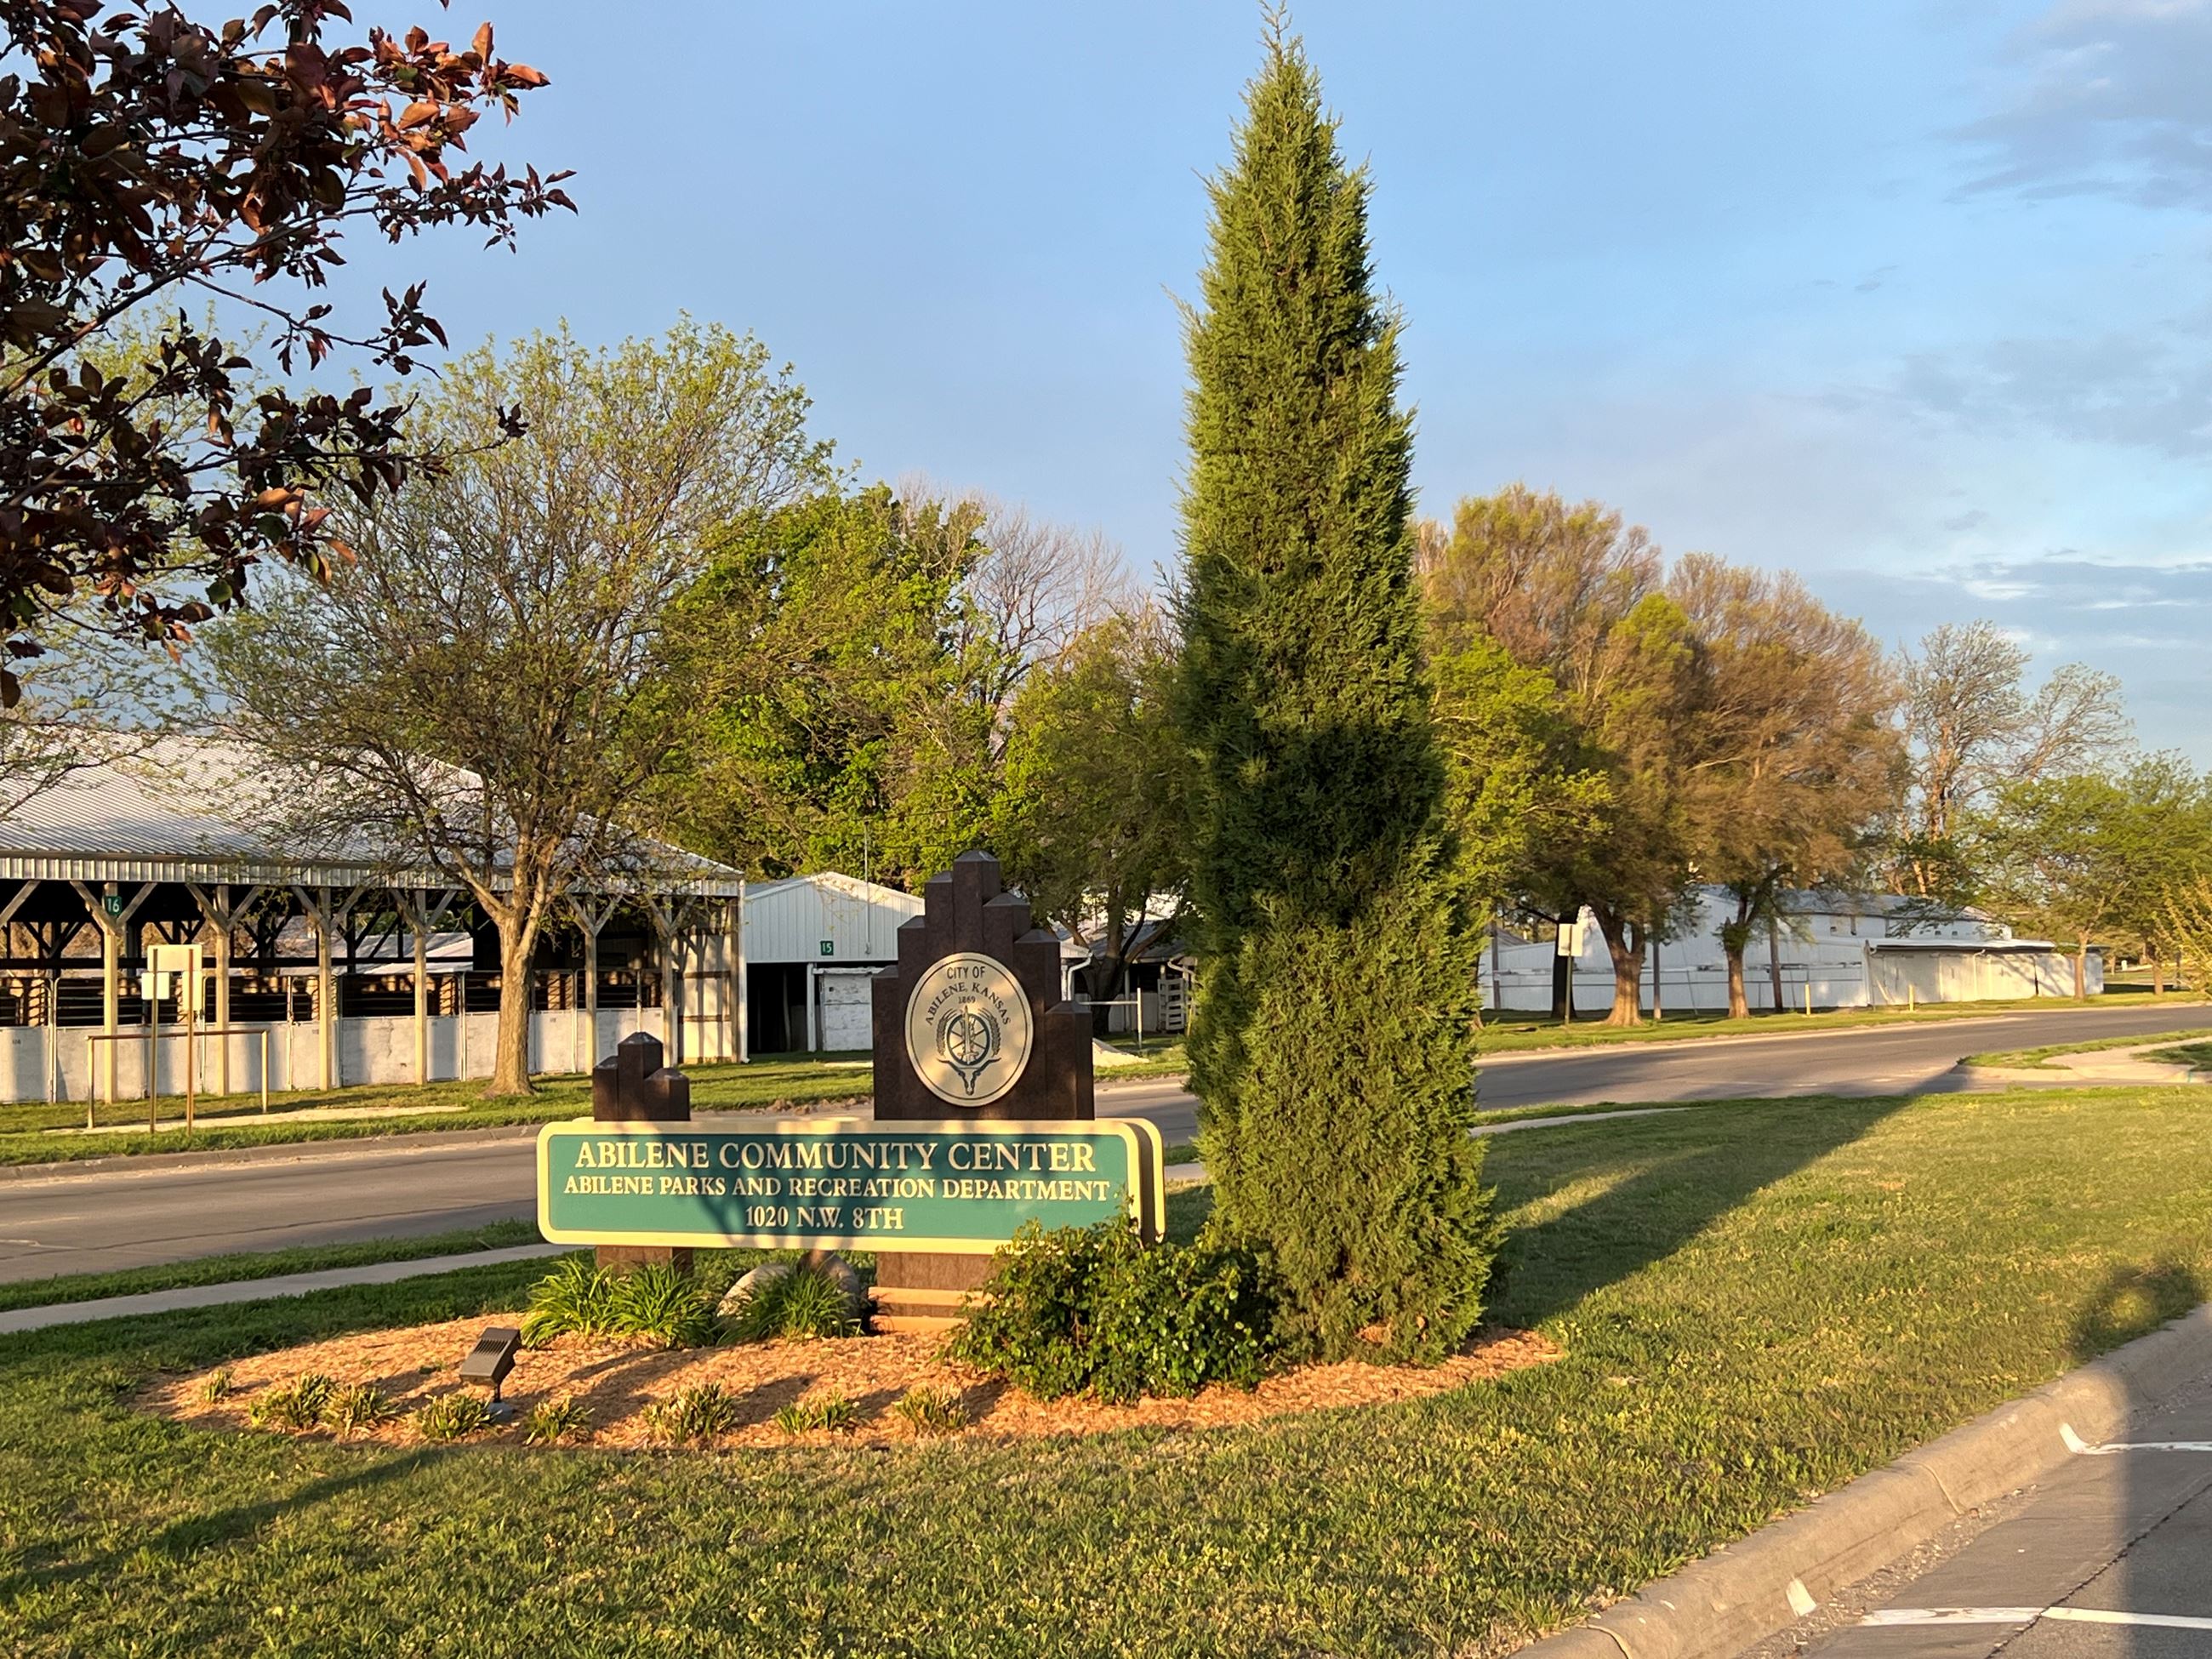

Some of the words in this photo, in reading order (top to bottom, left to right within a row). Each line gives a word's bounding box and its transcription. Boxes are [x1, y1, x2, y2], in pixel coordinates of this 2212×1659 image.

[107, 898, 120, 912] 16
[822, 942, 832, 953] 15
[946, 966, 969, 979] CITY
[972, 966, 985, 978] OF
[958, 995, 976, 1004] 1869
[972, 982, 1011, 1025] KANSAS
[575, 1141, 710, 1169] ABILENE
[719, 1142, 938, 1171] COMMUNITY
[948, 1143, 1096, 1172] CENTER
[564, 1176, 653, 1194] ABILENE
[659, 1176, 726, 1195] PARKS
[733, 1177, 781, 1197] AND
[789, 1177, 935, 1199] RECREATION
[943, 1179, 1110, 1201] DEPARTMENT
[745, 1206, 789, 1228] 1020
[796, 1206, 844, 1229] N.W.
[852, 1207, 904, 1230] 8TH
